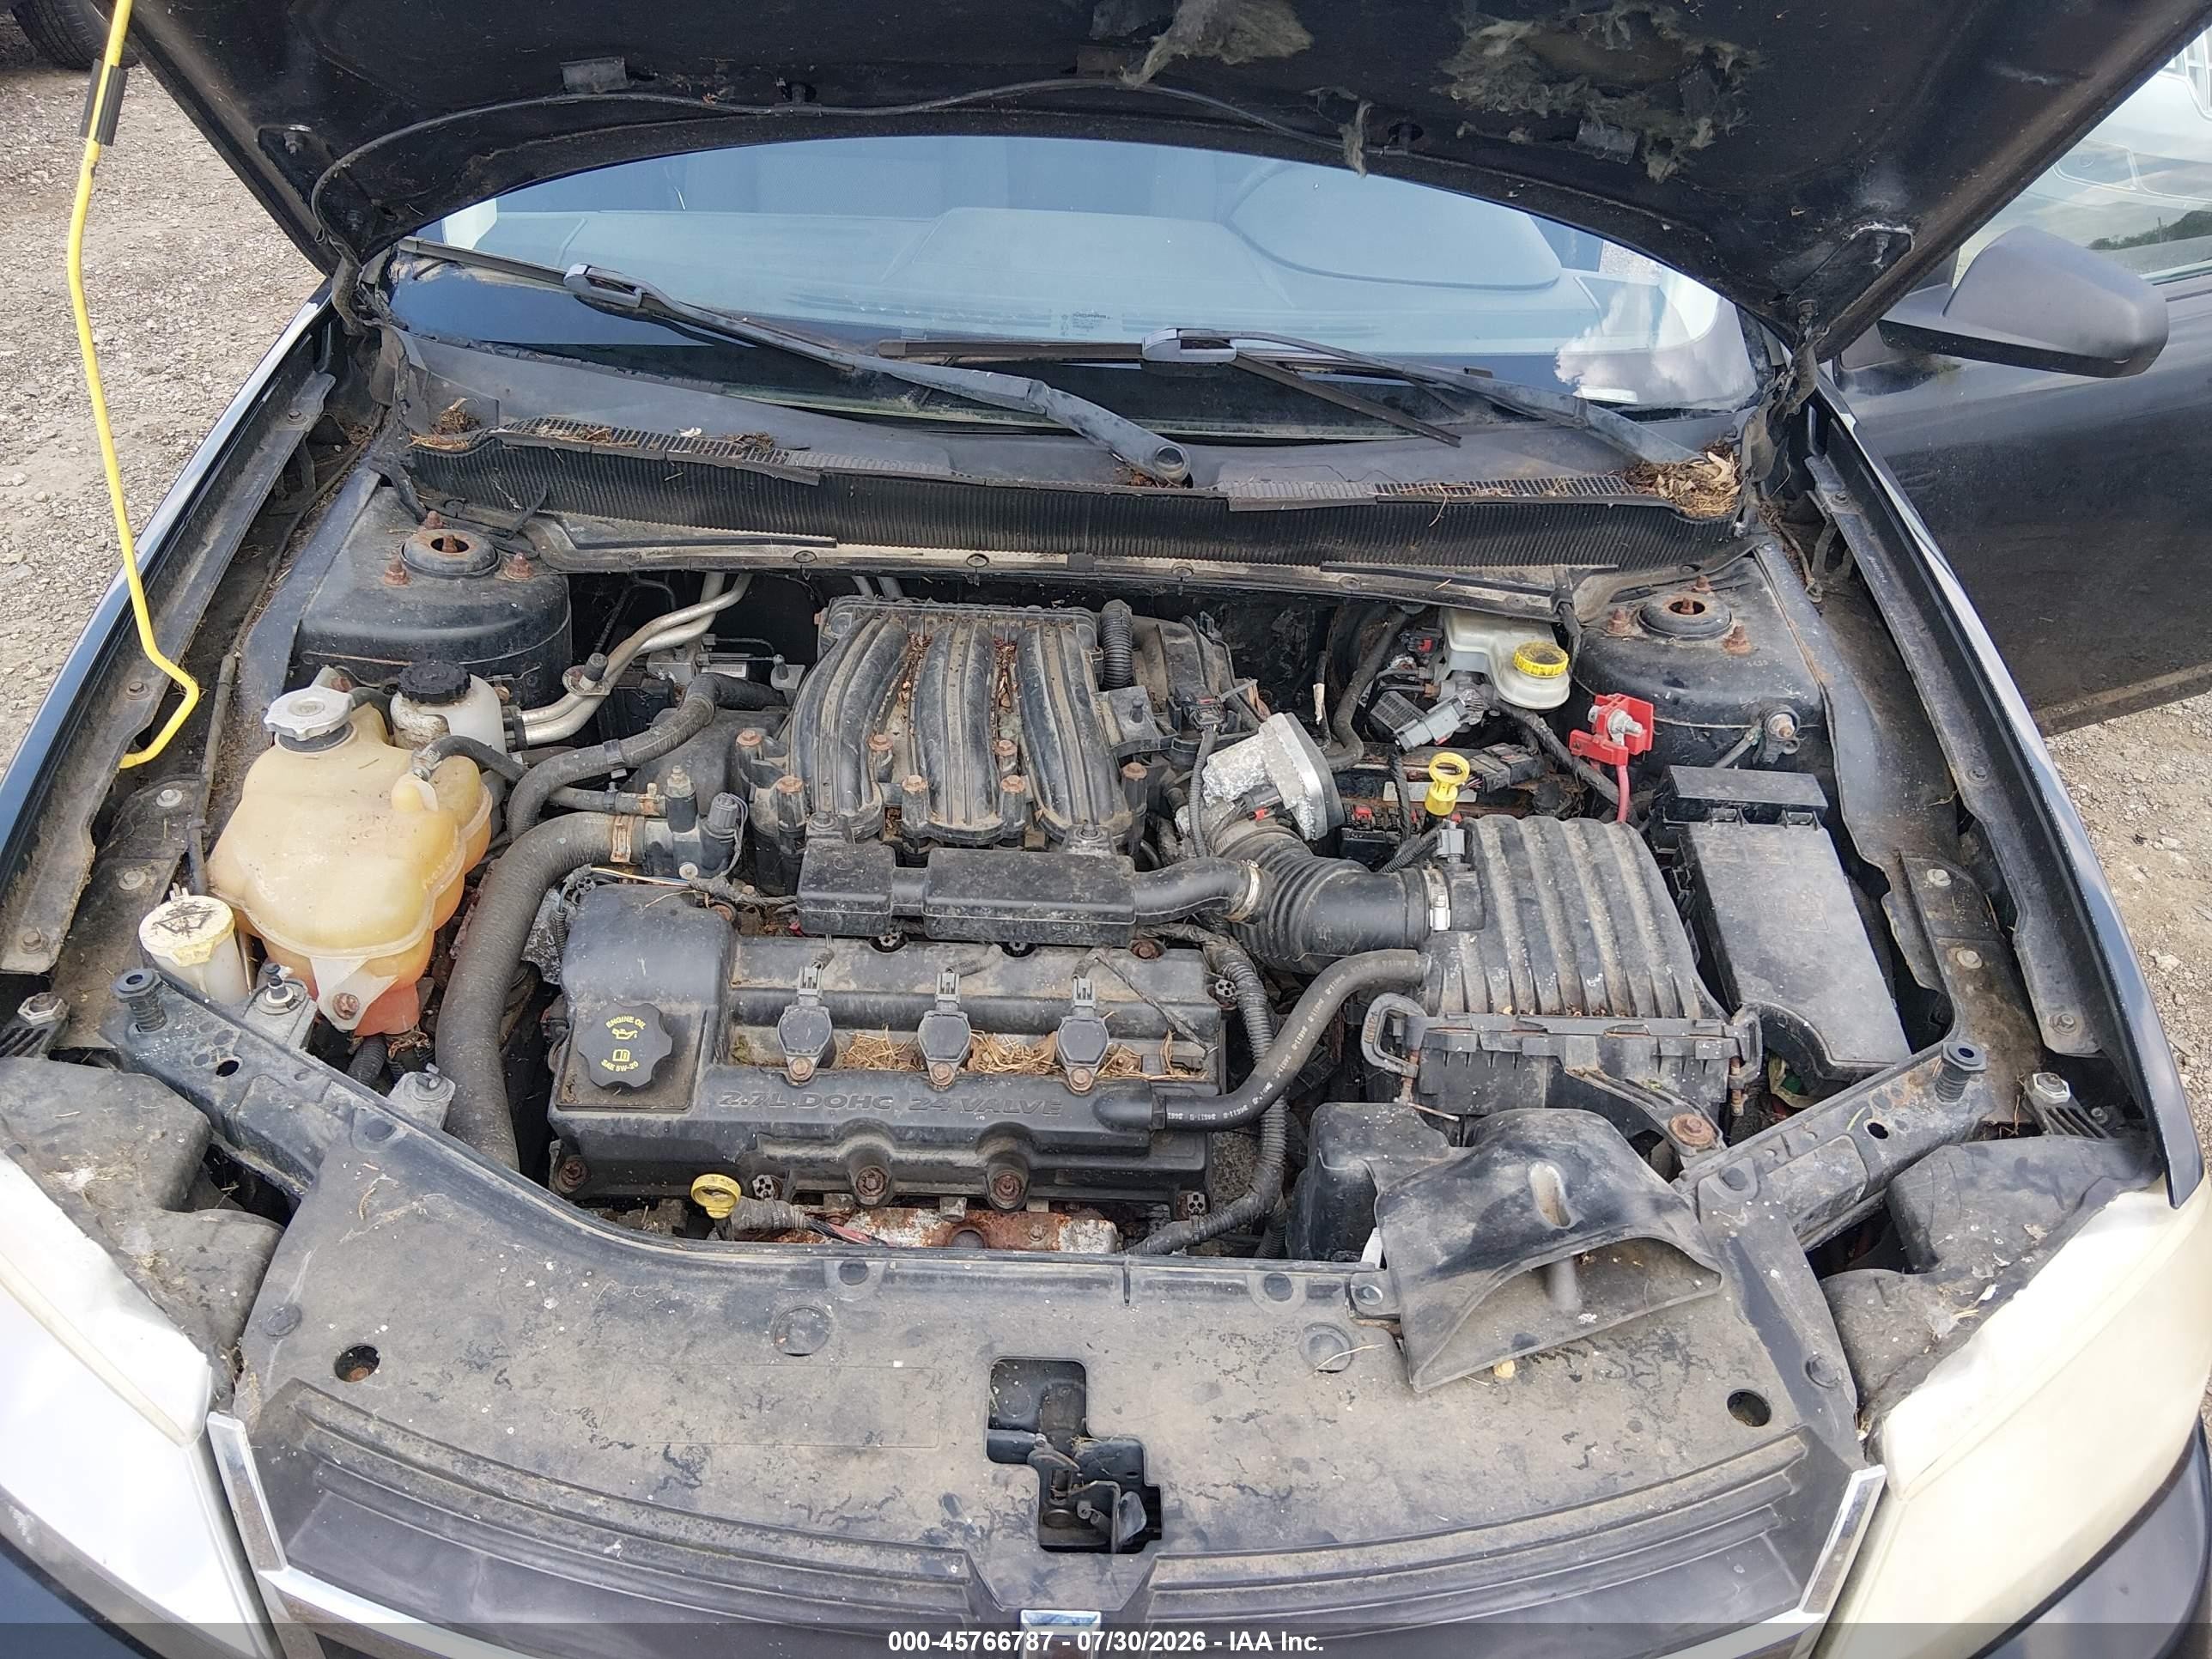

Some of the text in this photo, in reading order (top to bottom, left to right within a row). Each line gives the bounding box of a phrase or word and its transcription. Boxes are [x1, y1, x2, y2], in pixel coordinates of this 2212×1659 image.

[605, 1016, 647, 1030] ENGINE OIL
[601, 1059, 639, 1073] SAE 5W-20
[720, 1091, 1065, 1116] 2.7L DOHC 24 VALVE
